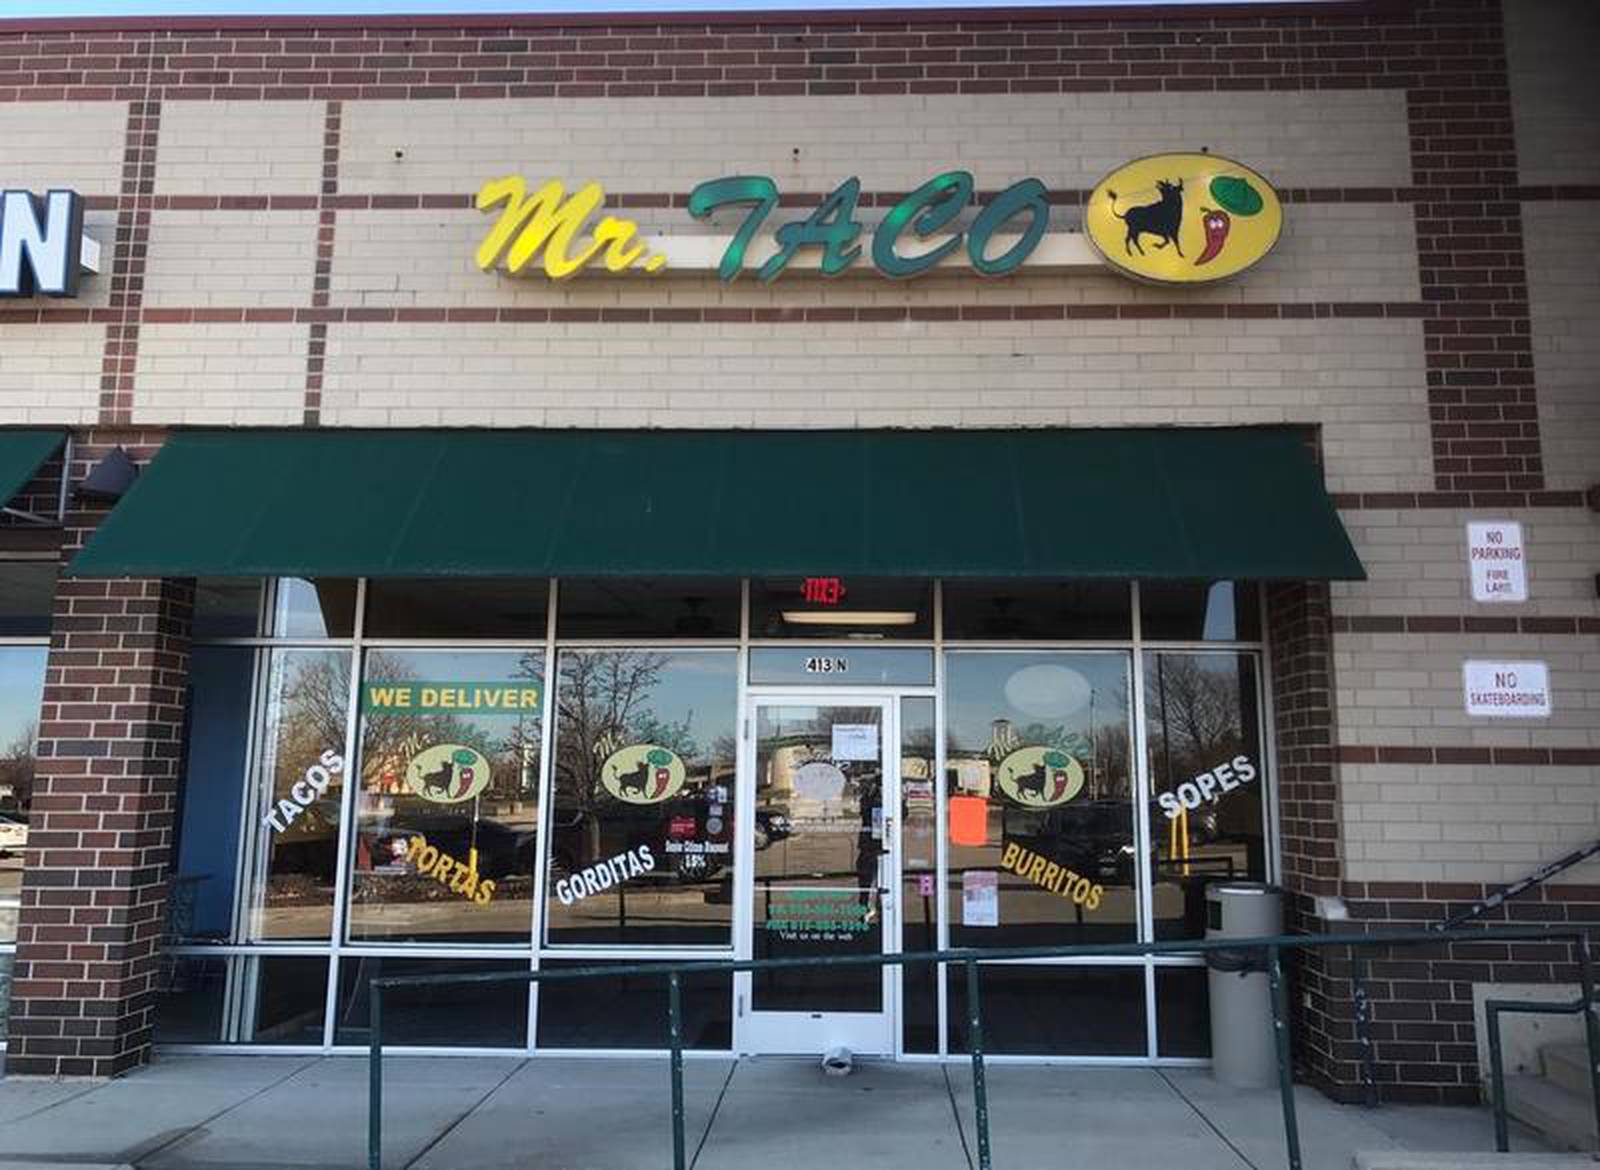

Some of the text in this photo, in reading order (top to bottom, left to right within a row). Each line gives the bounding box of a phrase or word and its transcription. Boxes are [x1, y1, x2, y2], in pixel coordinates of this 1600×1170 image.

[475, 170, 1050, 283] Mr. TACO
[1486, 531, 1503, 543] NO
[1472, 547, 1521, 561] PARKING
[807, 657, 846, 672] 413 N
[1495, 672, 1517, 688] NO
[369, 687, 539, 709] WE DELIVER
[1470, 693, 1546, 707] SKATEBOARDING
[263, 750, 344, 833] TACOS
[1157, 753, 1256, 820] SOPES
[556, 844, 655, 906] GORDITAS
[1001, 842, 1103, 911] BURRITOS
